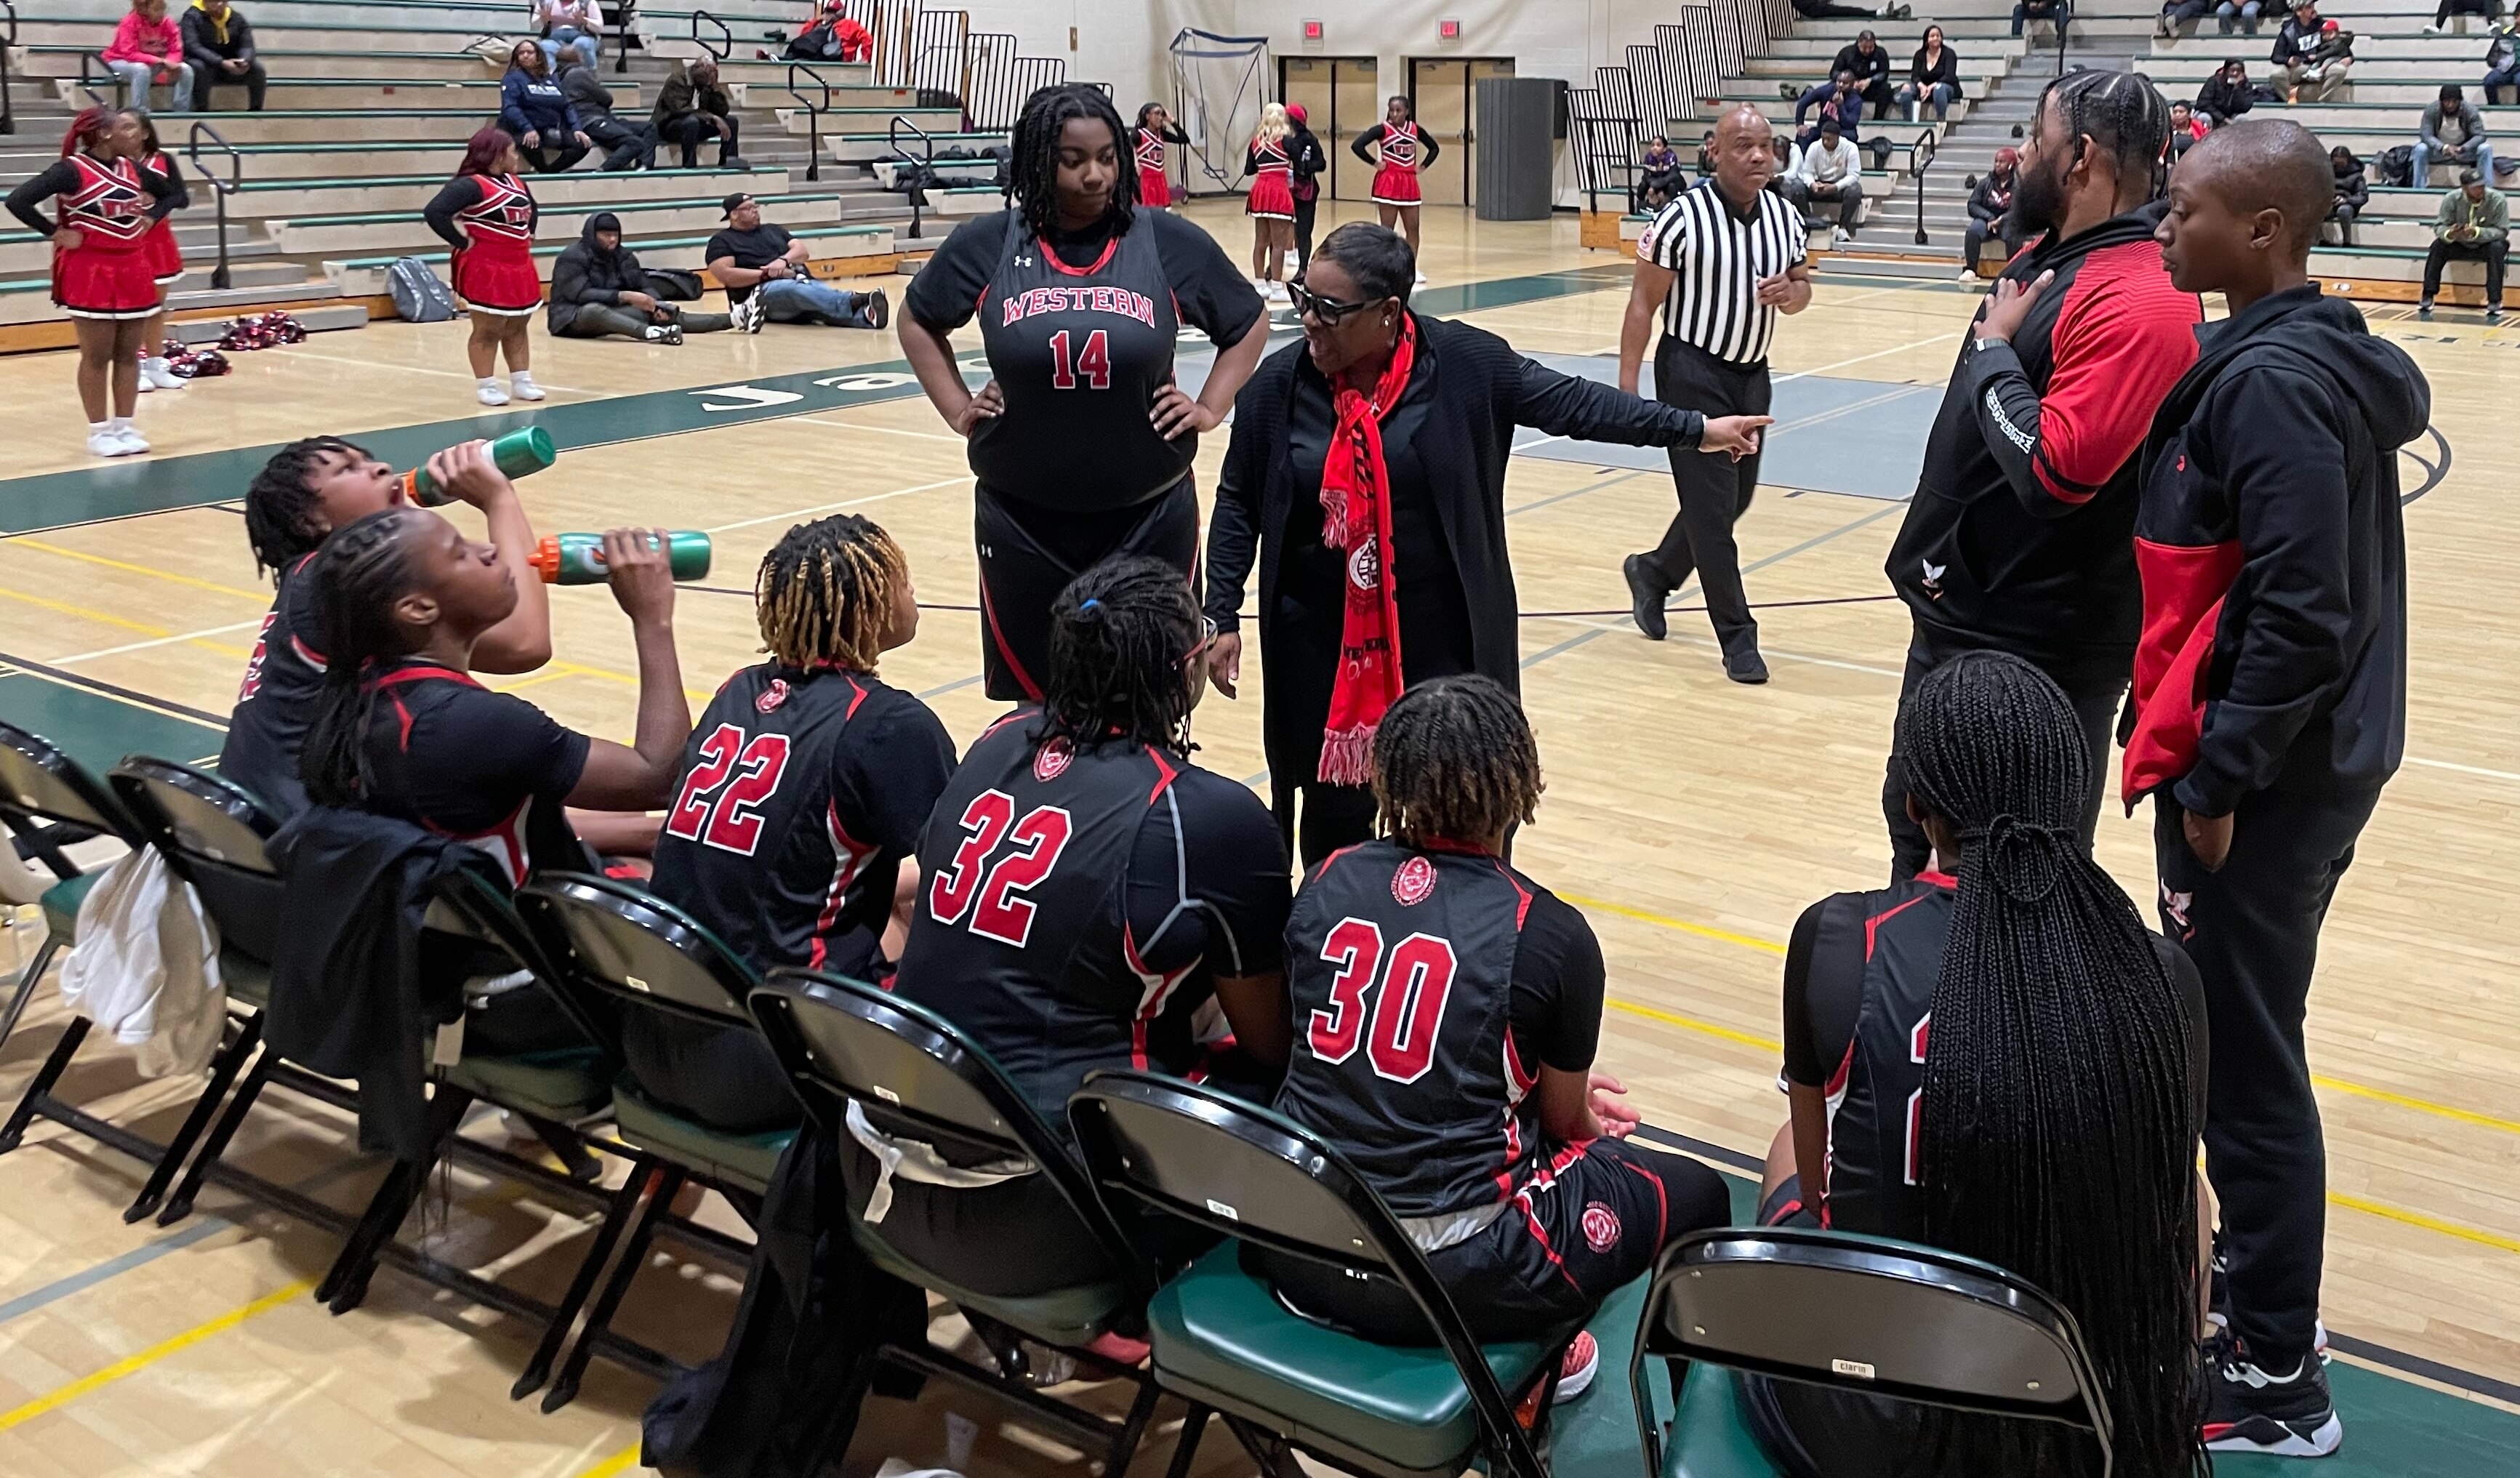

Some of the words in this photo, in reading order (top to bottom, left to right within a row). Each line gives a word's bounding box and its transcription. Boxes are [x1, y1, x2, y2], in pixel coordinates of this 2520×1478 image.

[1003, 286, 1155, 329] WESTERN
[1049, 329, 1110, 389] 14
[667, 722, 790, 856] 22
[930, 788, 1072, 948] 32
[1307, 916, 1458, 1085] 30
